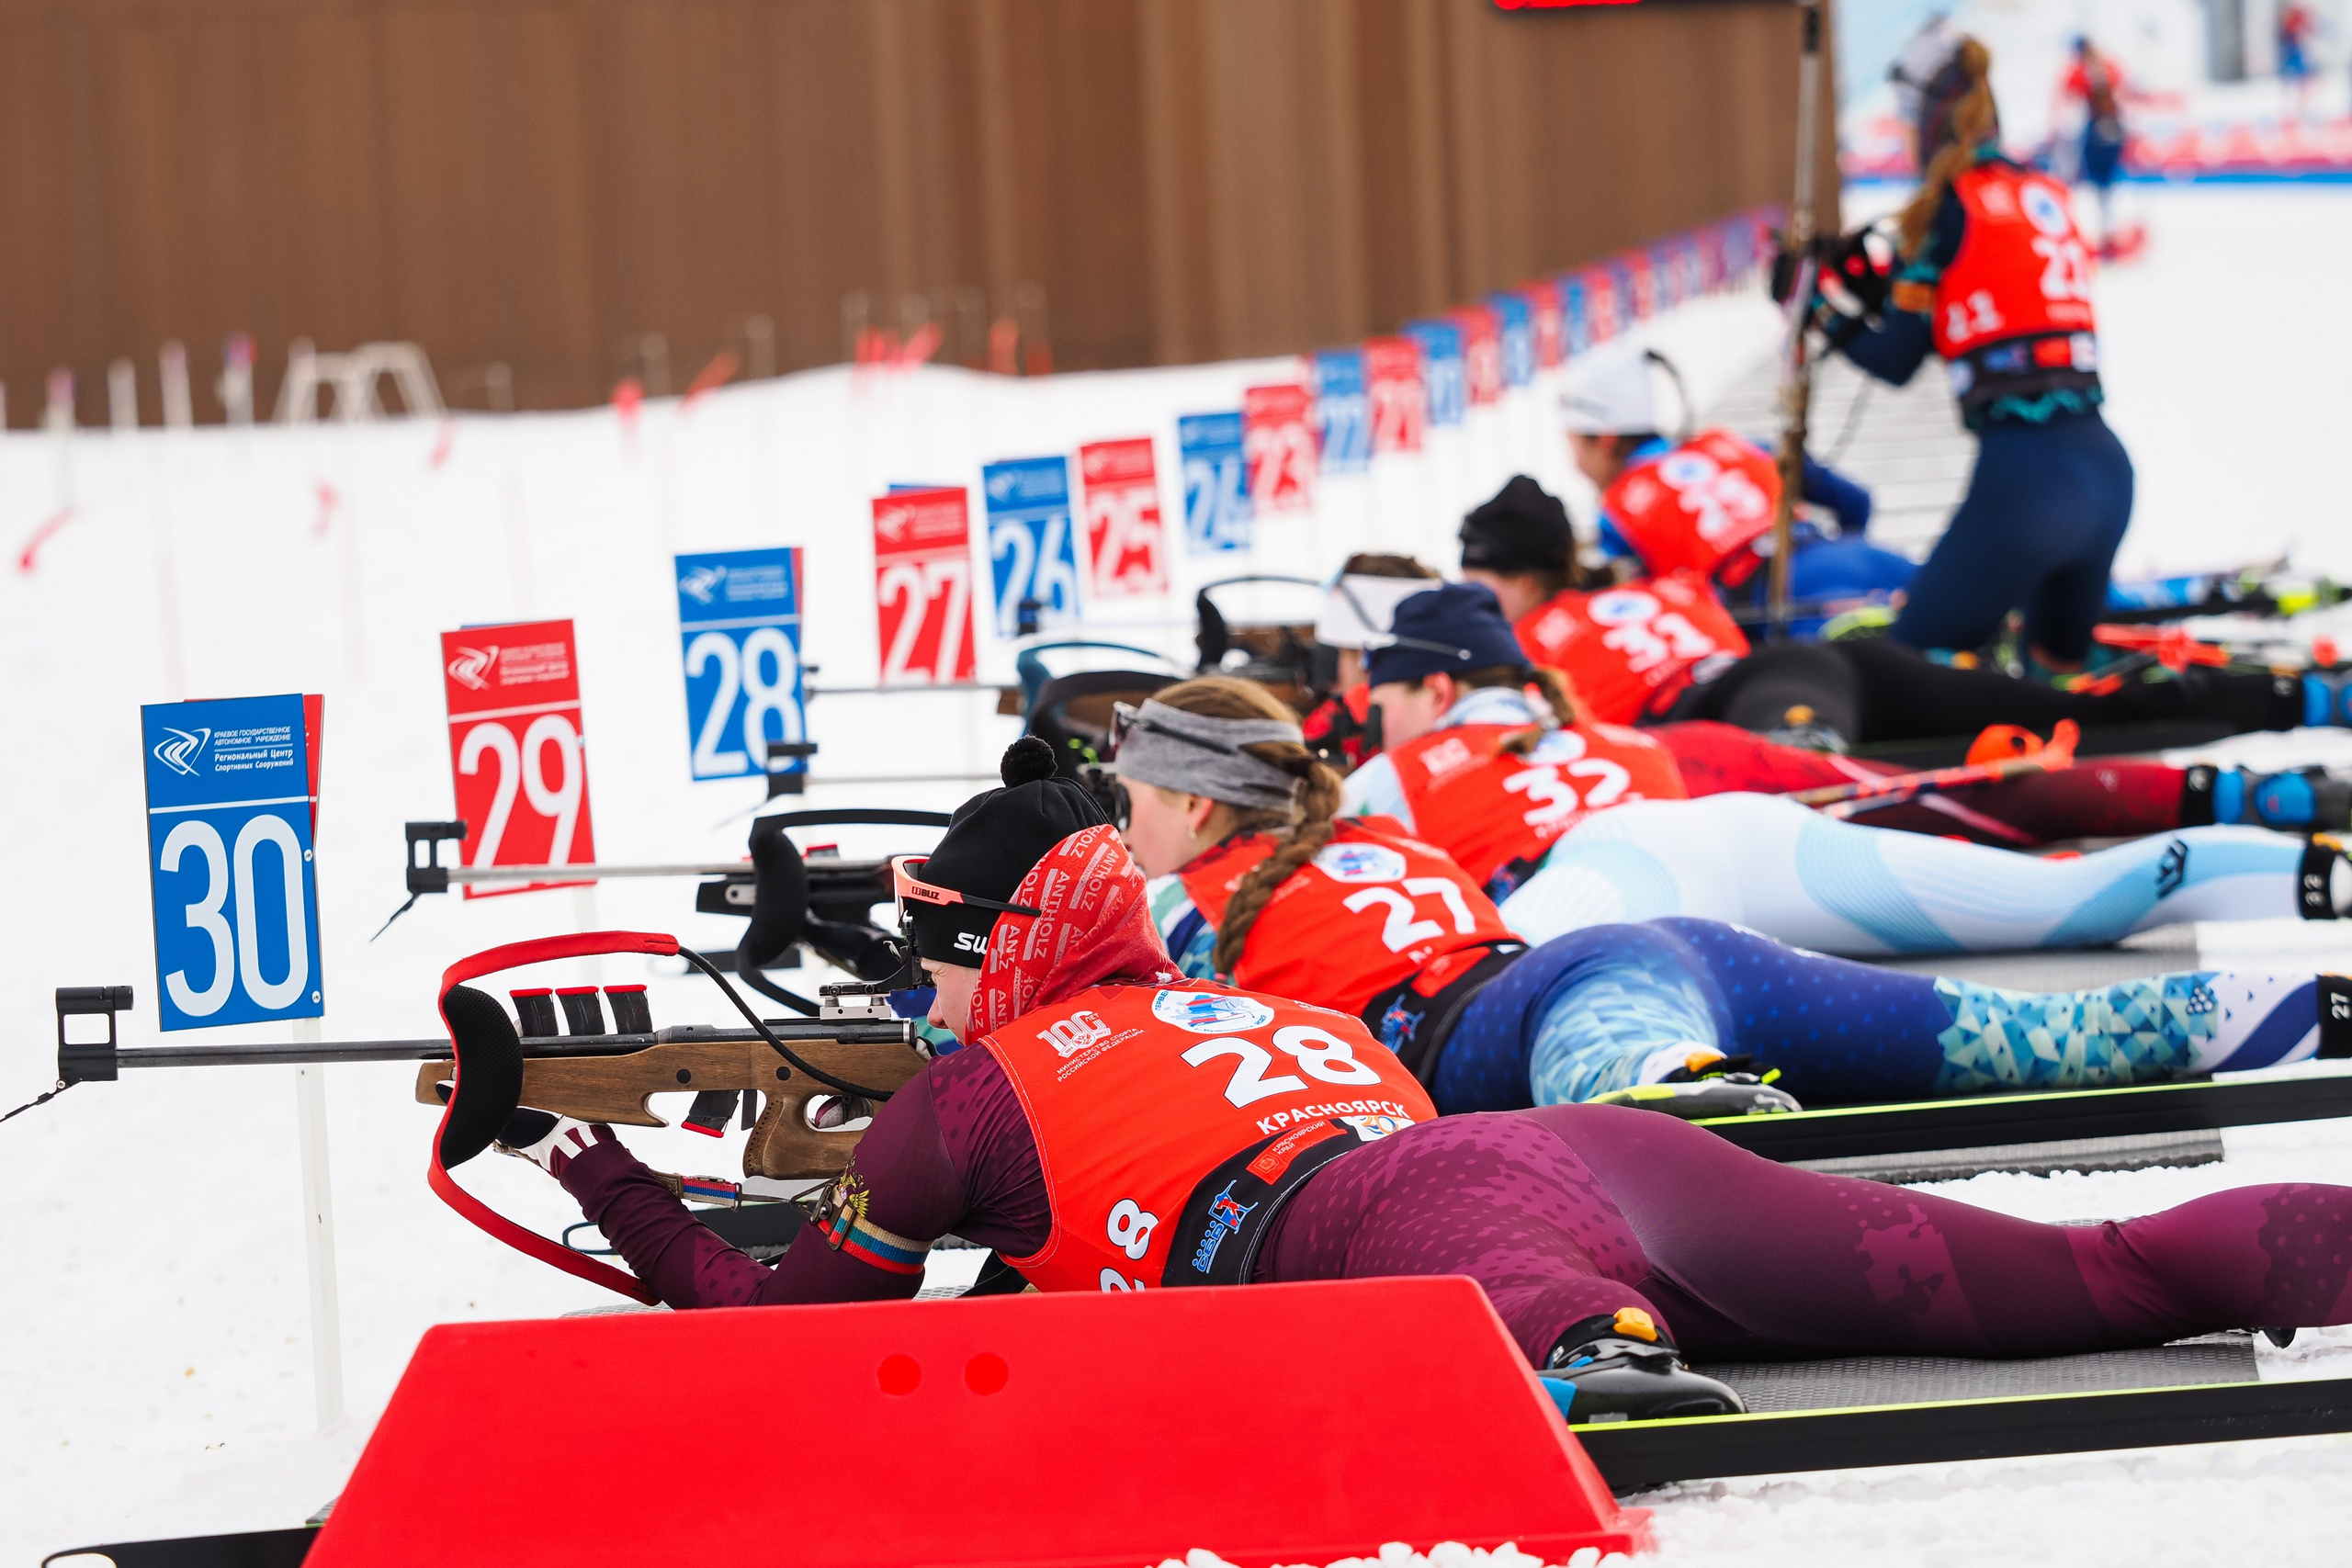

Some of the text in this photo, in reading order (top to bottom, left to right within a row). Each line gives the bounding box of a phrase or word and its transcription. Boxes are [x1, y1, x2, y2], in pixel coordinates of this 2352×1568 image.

[1087, 488, 1166, 596] 25
[990, 514, 1077, 634] 26
[879, 560, 970, 682] 27
[1602, 612, 1716, 673] 31
[685, 626, 802, 776] 28
[214, 727, 290, 739] КРАЕВОЕ ГОСУДАРСТВЕННОЕ
[214, 737, 252, 746] АВТОНОМНОЕ
[215, 750, 293, 761] Региональный Центр
[214, 760, 293, 773] Спортивных Сооружений
[1502, 758, 1632, 827] 32
[459, 715, 584, 896] 29
[1080, 848, 1120, 912] ANTHOLZ
[160, 814, 309, 1017] 30
[1034, 870, 1071, 959] ANTHOLZ
[1342, 876, 1477, 953] 27
[1084, 1012, 1100, 1022] ЛЕТ
[2330, 992, 2351, 1021] 27
[1056, 1028, 1138, 1075] МИНИСТЕРСТВО СПОРТА
[1057, 1029, 1146, 1083] РОССИЙСКОЙ ФЕДЕРАЦИИ
[1181, 1025, 1382, 1110] 28
[1256, 1100, 1411, 1135] КРАСНОЯРСК
[1272, 1120, 1326, 1153] КРАСНОЯРСКИЙ
[1277, 1142, 1296, 1156] КРАЙ
